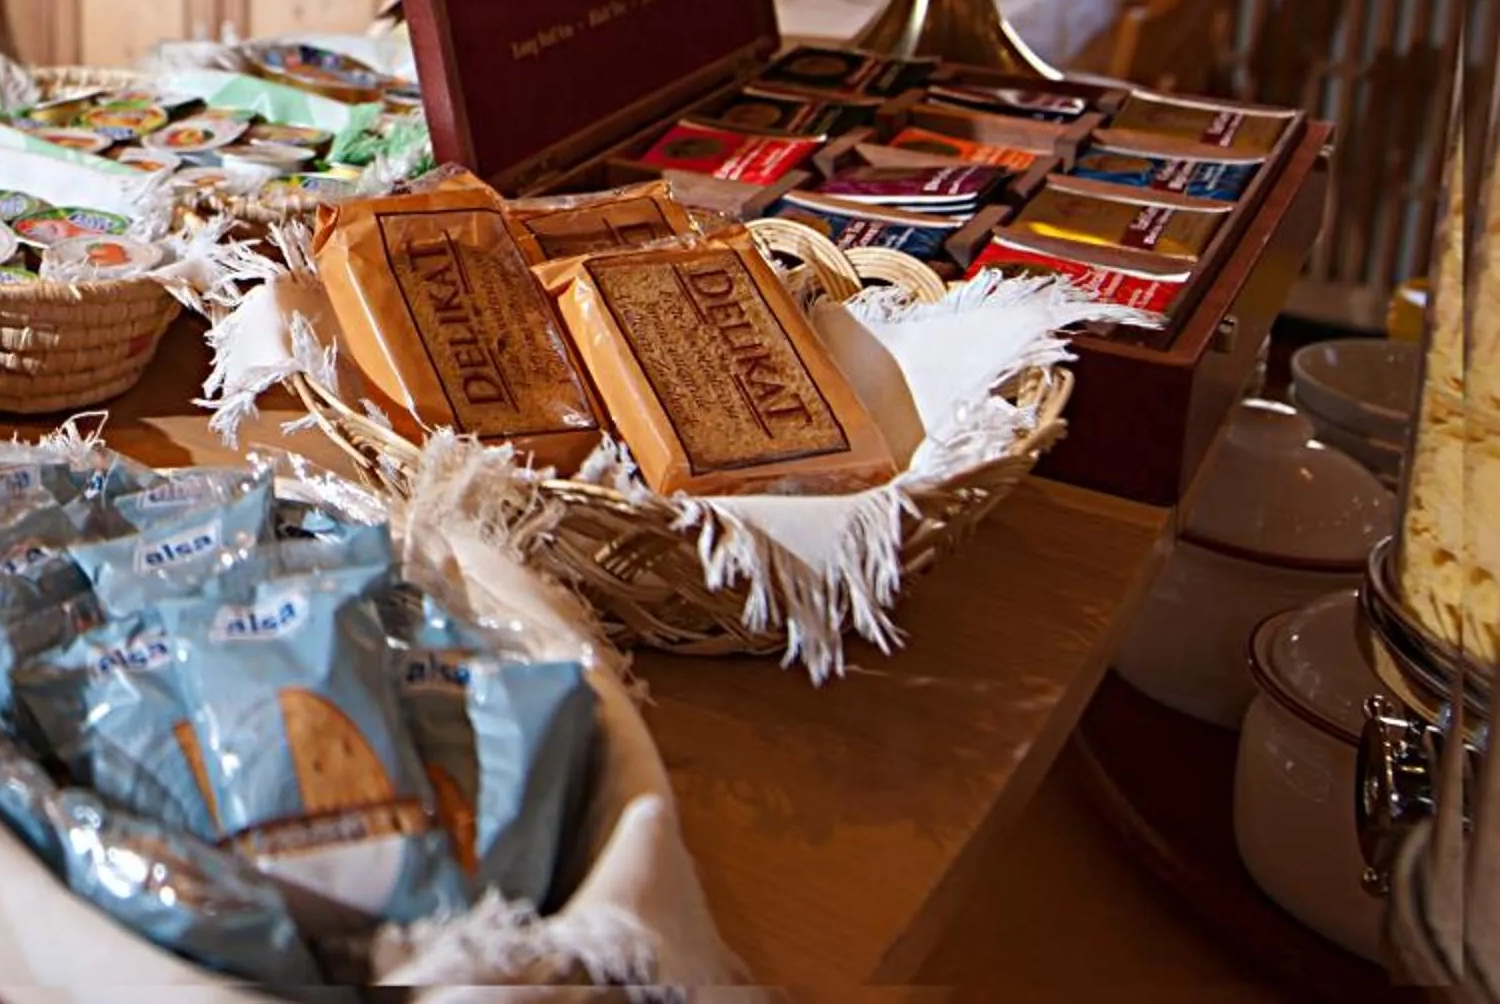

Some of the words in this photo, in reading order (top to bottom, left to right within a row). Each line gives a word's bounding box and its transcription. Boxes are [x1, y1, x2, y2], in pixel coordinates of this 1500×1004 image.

[406, 239, 509, 405] DELIKAT
[687, 268, 813, 425] DELIKAT
[143, 533, 213, 567] alsa
[226, 601, 296, 635] alsa
[98, 638, 169, 675] alsa
[405, 650, 471, 685] alsa
